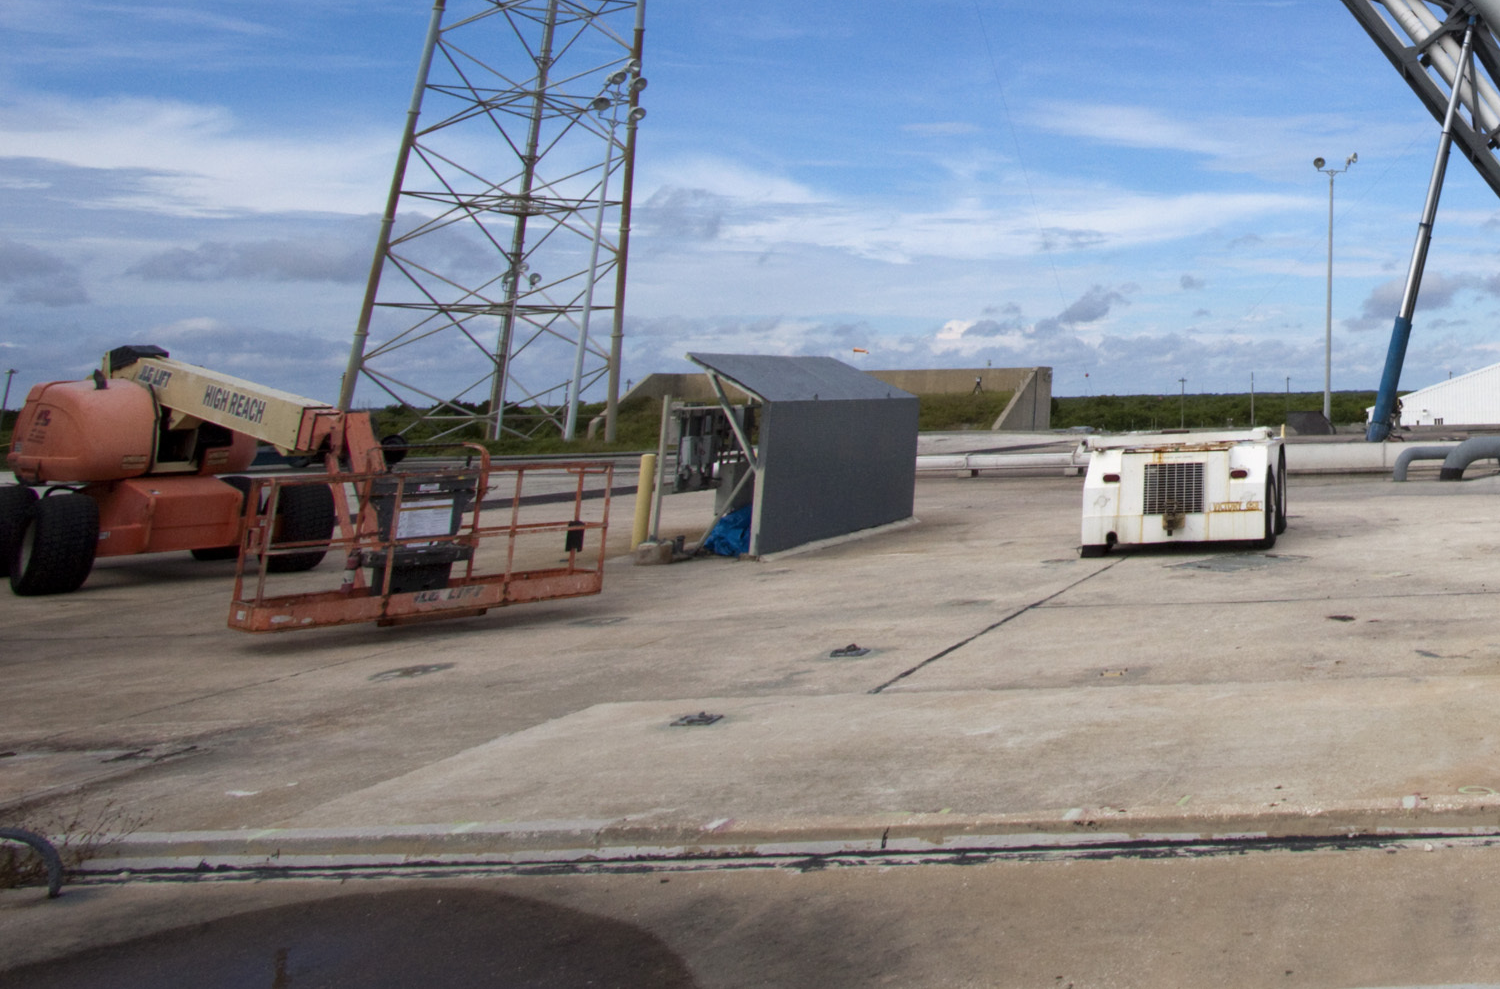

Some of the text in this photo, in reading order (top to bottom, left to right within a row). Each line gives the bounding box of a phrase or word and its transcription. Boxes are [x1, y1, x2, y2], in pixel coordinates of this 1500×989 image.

[138, 365, 172, 388] JLG LIFT
[202, 385, 267, 424] HIGH REACH
